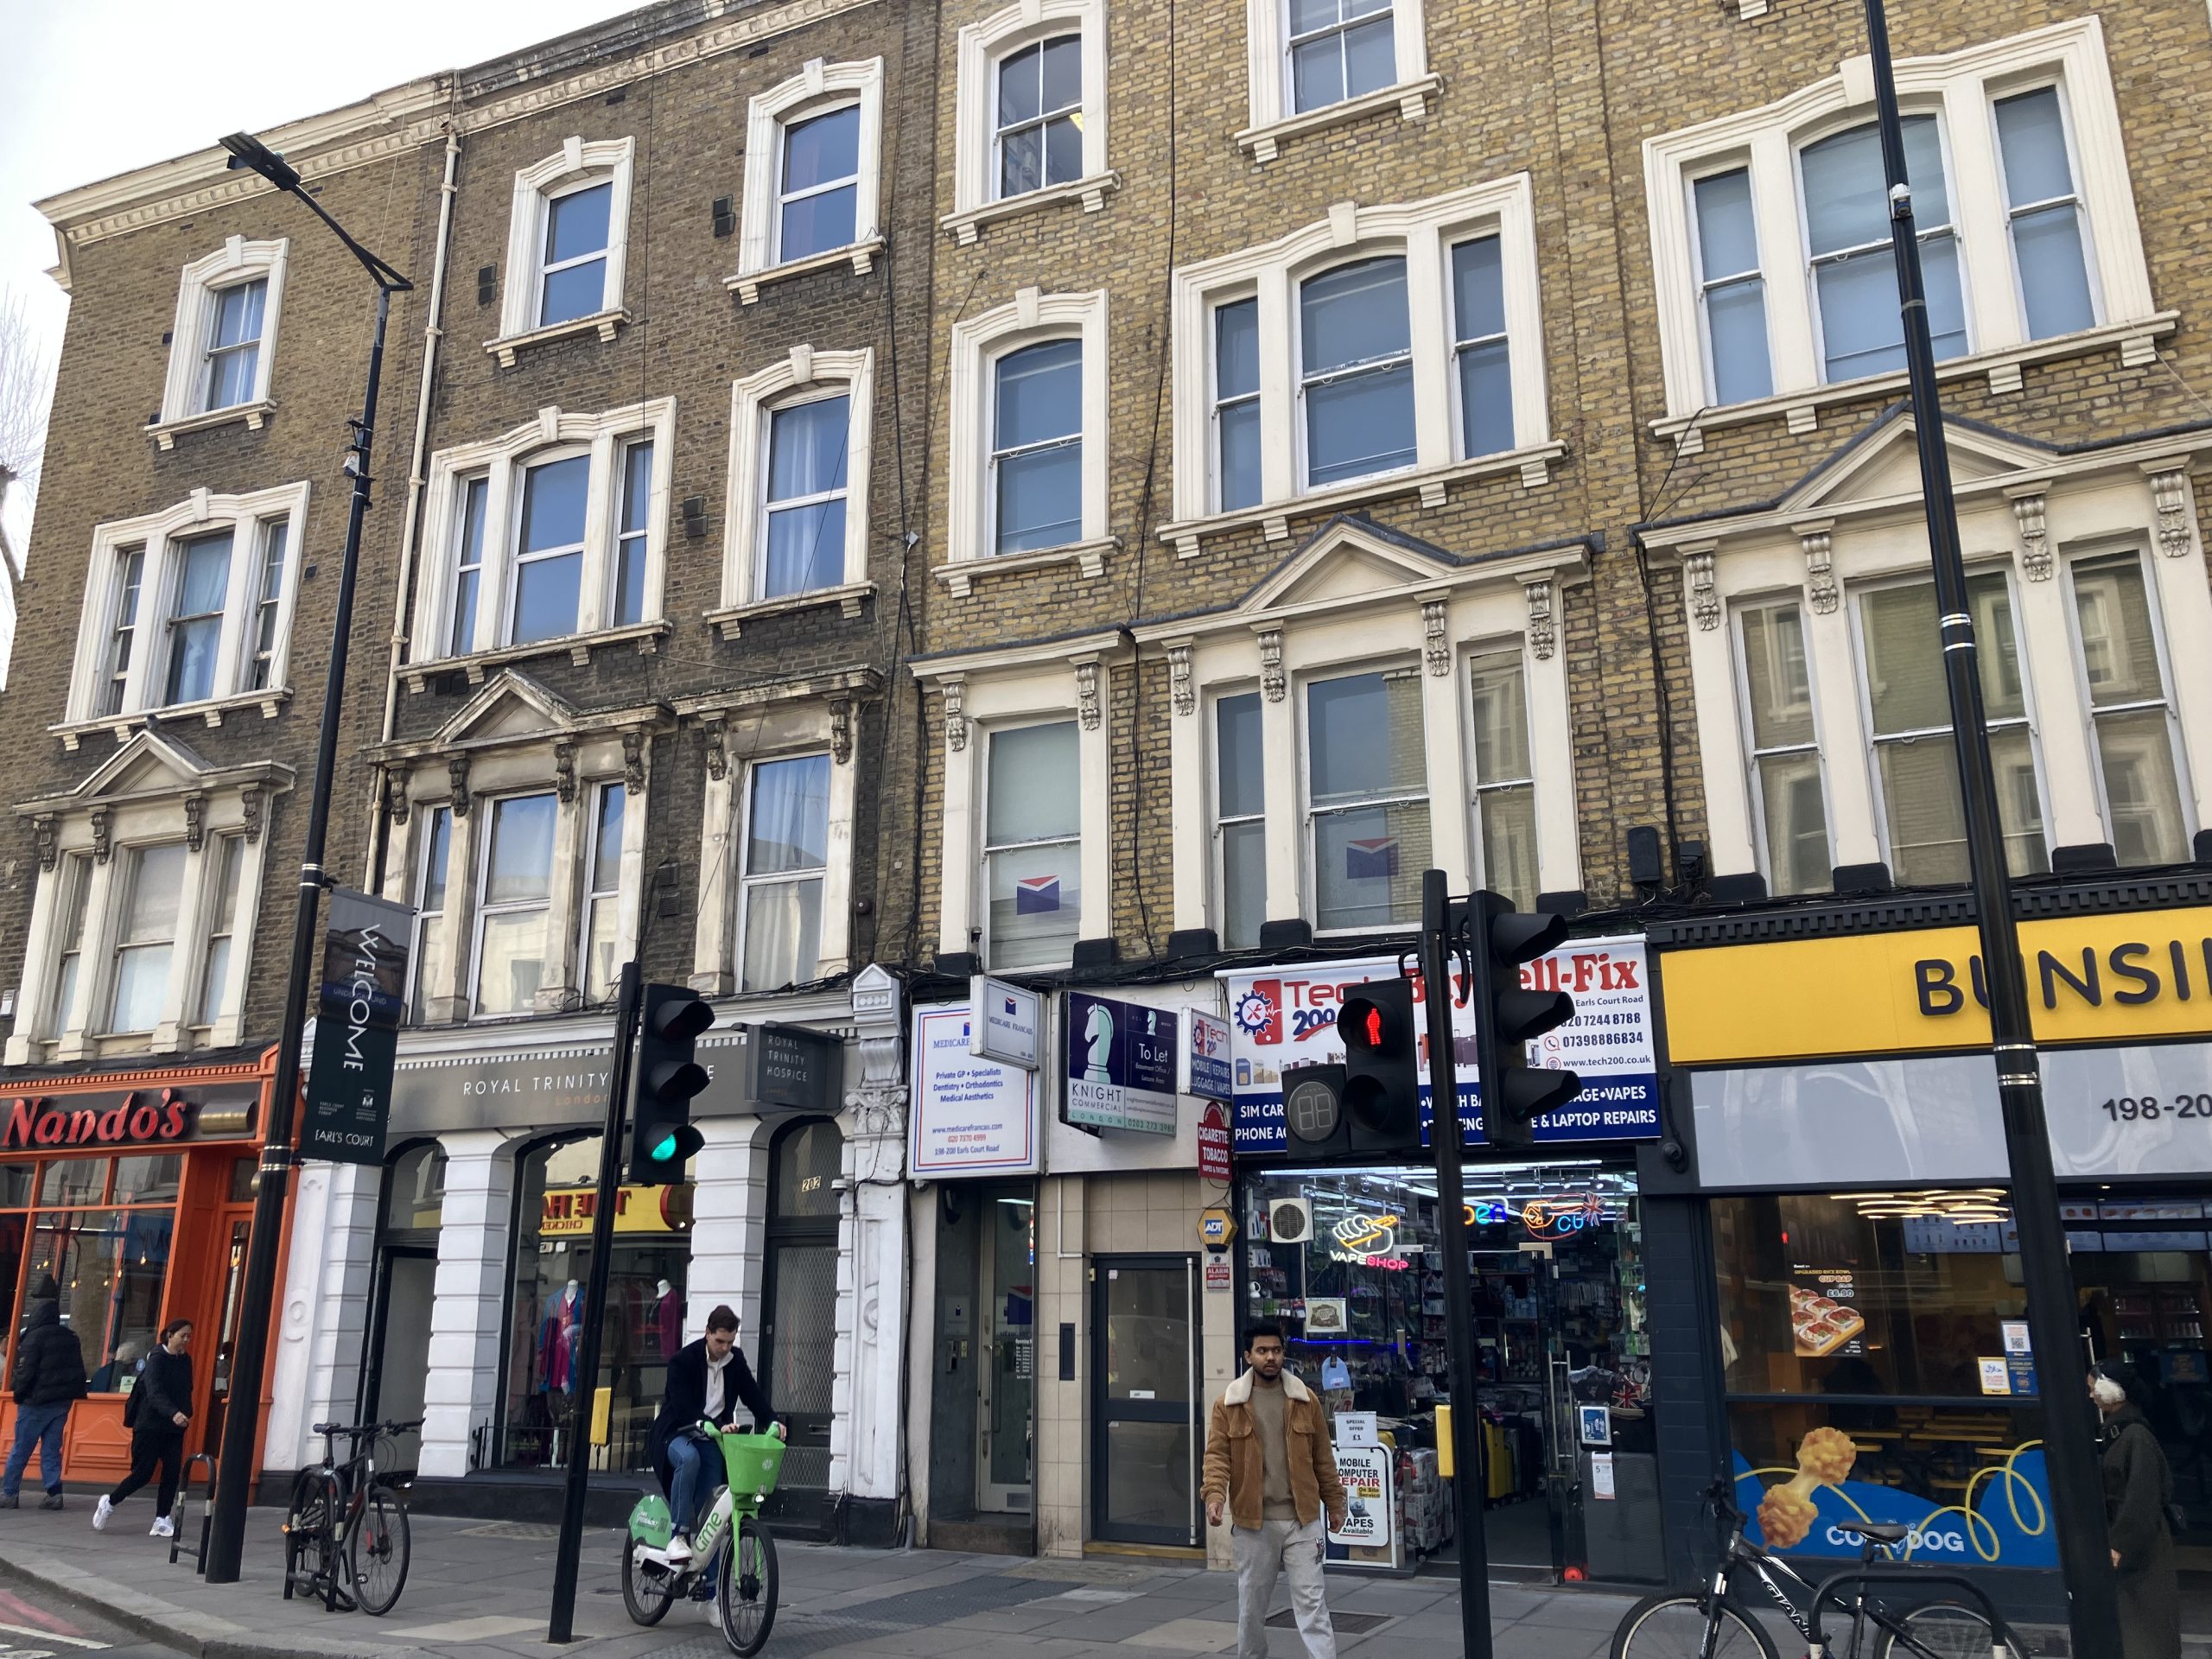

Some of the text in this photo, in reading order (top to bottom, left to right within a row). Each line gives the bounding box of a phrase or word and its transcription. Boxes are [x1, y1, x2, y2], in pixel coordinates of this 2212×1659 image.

[343, 924, 380, 1071] WELCOME
[1284, 976, 1370, 1007] Tec
[1598, 997, 1620, 1006] Court
[1293, 1007, 1336, 1035] 200
[1584, 1014, 1611, 1026] 7244
[1613, 1012, 1641, 1024] 8788
[1205, 1024, 1228, 1044] Tech
[768, 1035, 798, 1049] ROYAL
[768, 1050, 805, 1065] TRINITY
[1139, 1043, 1167, 1063] To Let
[1192, 1058, 1230, 1078] MOBILE REPAIRS
[1564, 1055, 1650, 1067] www.tech200.co.uk
[767, 1065, 807, 1082] HOSPICE
[971, 1068, 1001, 1079] Specialists
[463, 1072, 608, 1096] ROYAL TRINITY
[933, 1080, 1003, 1092] Dentistry Orthodontics
[1217, 1081, 1231, 1095] VAPES
[940, 1092, 994, 1103] Medical Aesthetics
[1072, 1084, 1121, 1102] KNIGHT
[1605, 1085, 1646, 1100] VAPES
[1072, 1098, 1122, 1112] COMMERCIAL
[1241, 1104, 1284, 1118] SIM CAR
[2, 1088, 187, 1147] Nando's
[1072, 1112, 1122, 1125] LONDON
[1128, 1119, 1144, 1128] 0203
[1541, 1115, 1549, 1128] &
[1553, 1112, 1600, 1128] LAPTOP
[1605, 1109, 1656, 1125] REPAIRS
[315, 1129, 373, 1147] EARL'S COURT
[1235, 1127, 1274, 1141] PHONE
[970, 1145, 985, 1154] Court
[1203, 1147, 1228, 1163] TOBACCO
[804, 1177, 820, 1190] 202
[1205, 1222, 1223, 1231] ADT
[1558, 1215, 1593, 1232] CU
[1340, 1459, 1370, 1468] MOBILE
[1339, 1469, 1378, 1478] OMPUTER
[1339, 1478, 1380, 1487] EPAIR
